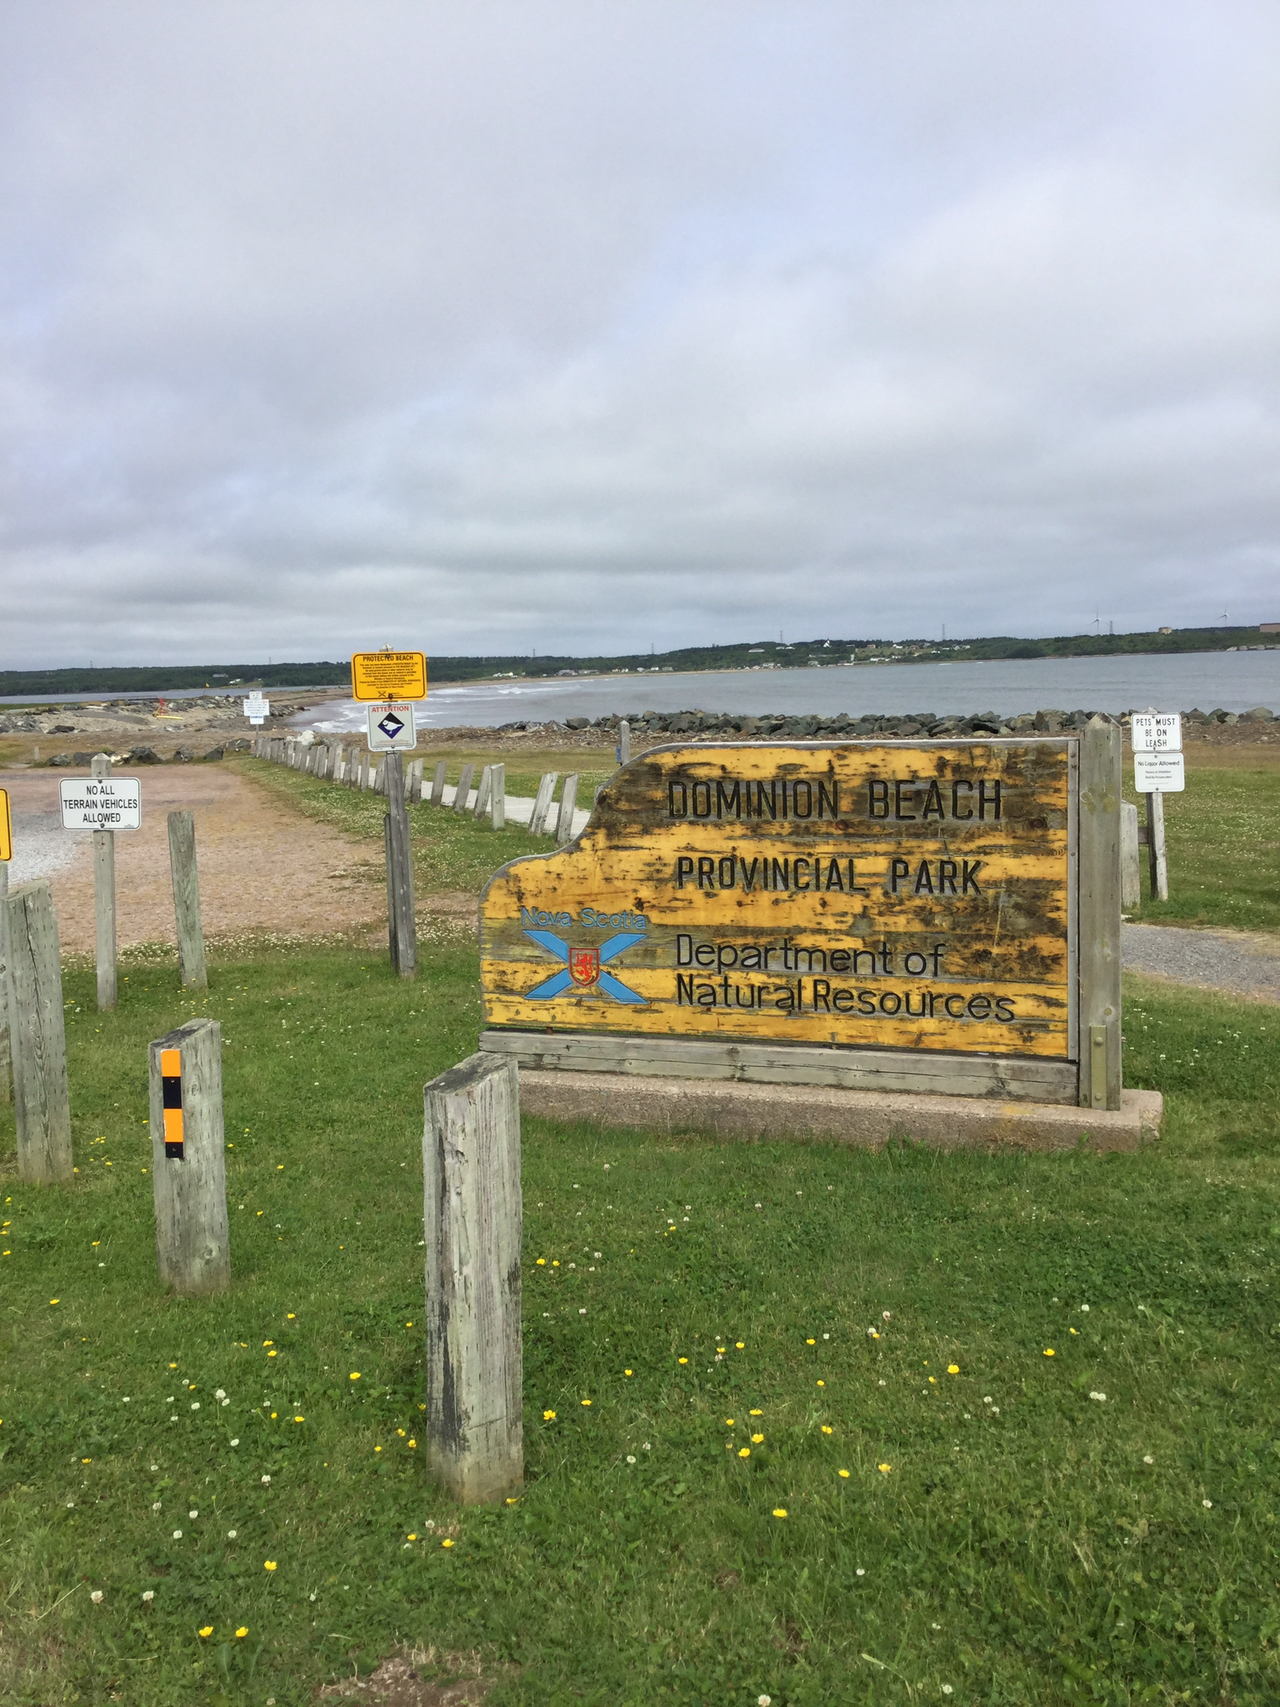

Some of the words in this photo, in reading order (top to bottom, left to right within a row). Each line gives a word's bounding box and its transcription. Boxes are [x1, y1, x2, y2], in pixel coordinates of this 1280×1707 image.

[1136, 718, 1152, 726] PETS
[86, 786, 98, 795] NO
[99, 785, 115, 795] ALL
[668, 779, 839, 821] DOMINION
[868, 779, 1001, 822] BEACH
[63, 799, 98, 809] TERRAIN
[100, 799, 138, 808] VEHICLES
[82, 812, 121, 823] ALLOWED
[677, 856, 866, 893] PROVINCIAL
[891, 859, 982, 896] PARK
[521, 906, 572, 927] Nova
[580, 907, 647, 930] Scotia
[676, 933, 892, 975] Department
[904, 943, 946, 977] of
[676, 973, 802, 1012] Natural
[813, 979, 1016, 1023] Resources
